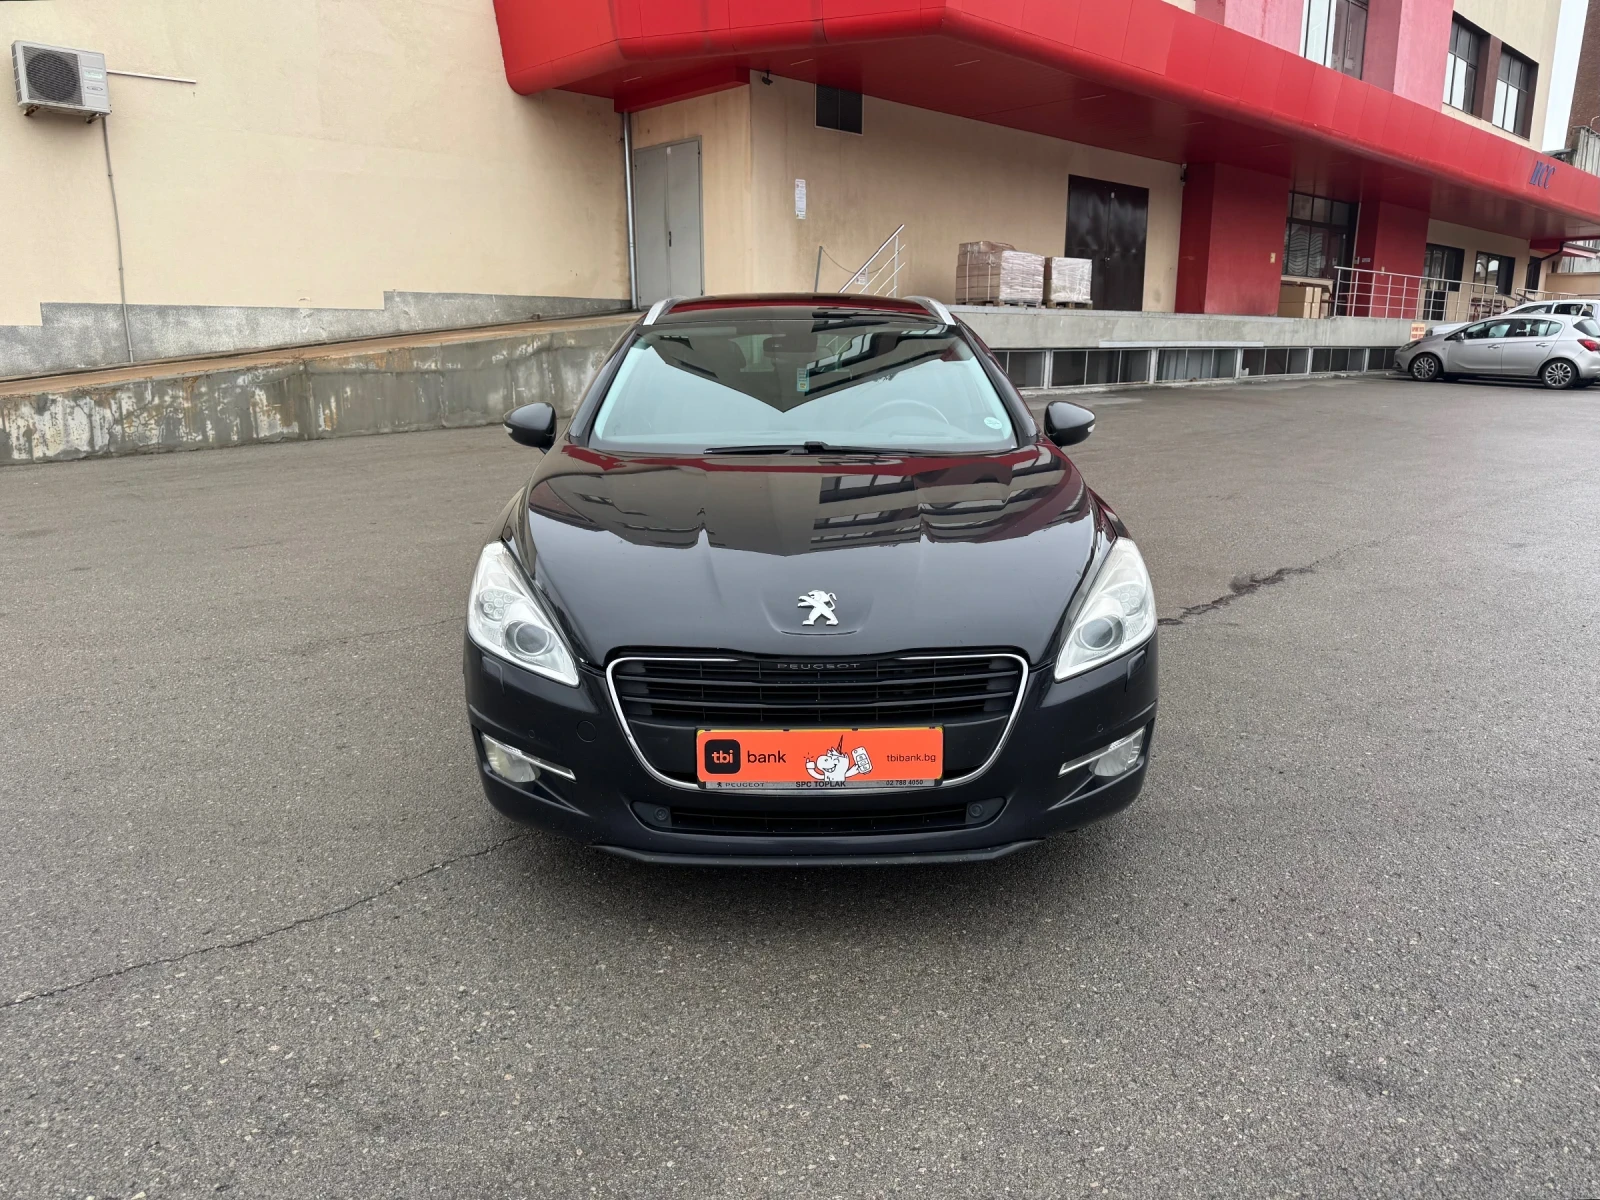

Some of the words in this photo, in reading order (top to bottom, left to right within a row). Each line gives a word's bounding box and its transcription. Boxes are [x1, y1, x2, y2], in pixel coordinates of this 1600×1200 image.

[711, 750, 734, 764] tbi
[747, 750, 787, 764] bank
[886, 753, 936, 763] tbibank.bg
